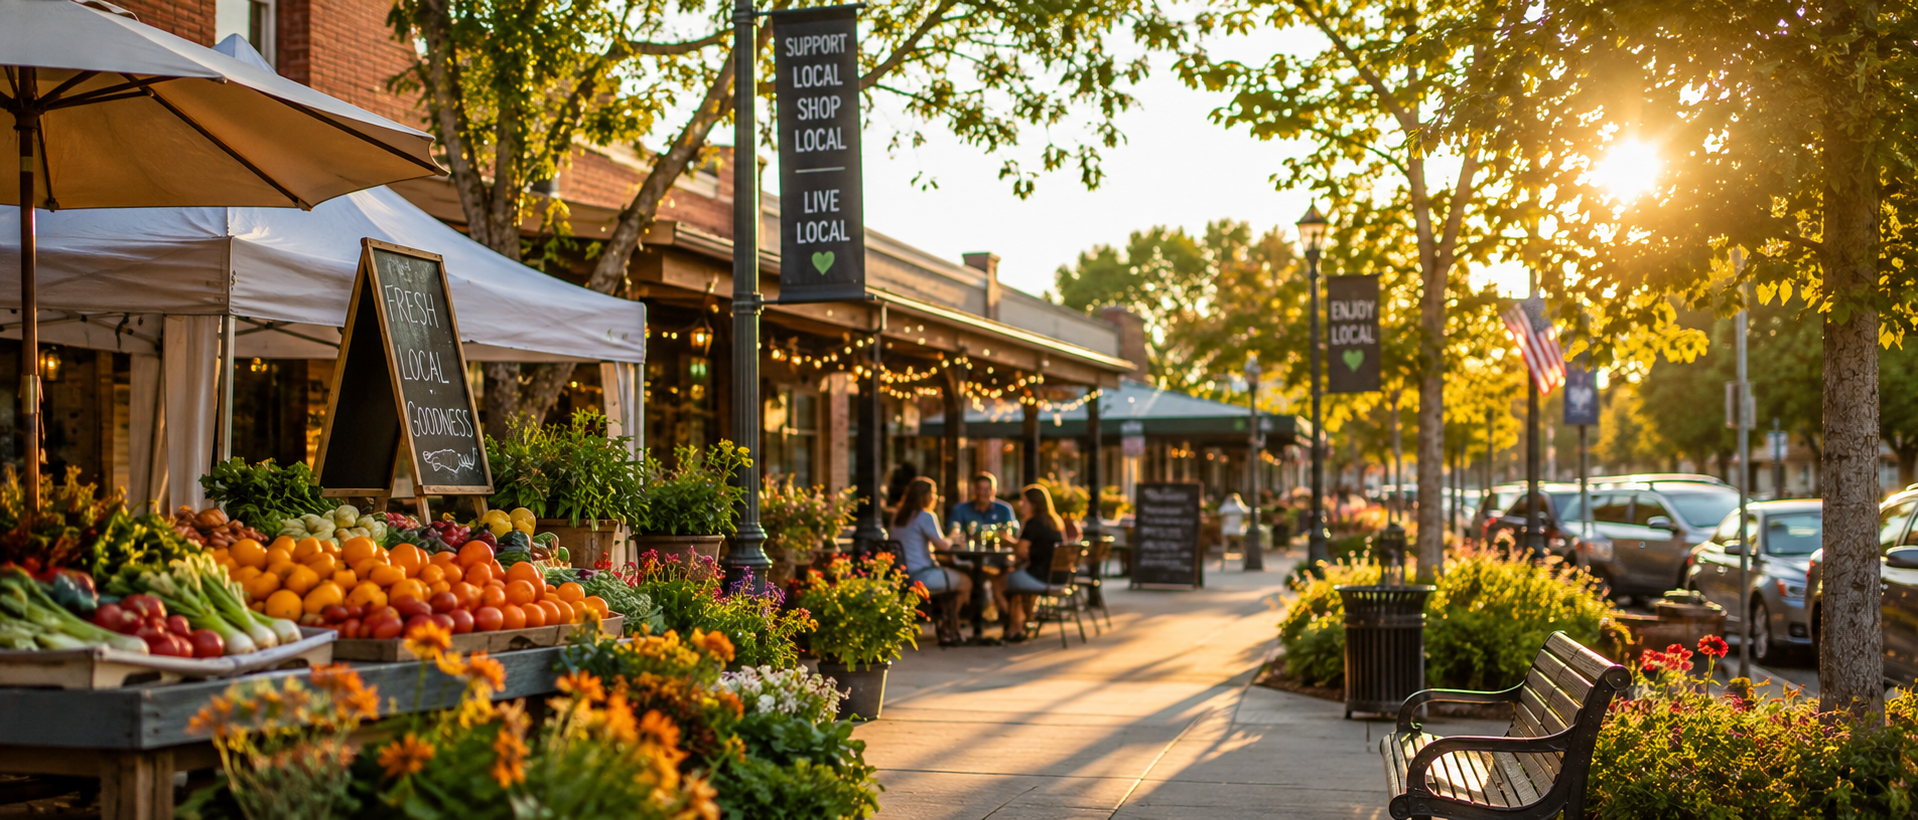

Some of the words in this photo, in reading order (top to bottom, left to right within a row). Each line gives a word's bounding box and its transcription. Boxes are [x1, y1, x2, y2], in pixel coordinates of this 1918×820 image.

[785, 33, 847, 57] SUPPORT
[793, 63, 843, 88] LOCAL
[797, 95, 841, 120] SHOP
[795, 127, 847, 152] LOCAL
[804, 189, 840, 214] LIVE
[796, 219, 850, 244] LOCAL
[385, 284, 439, 329] FRESH
[1331, 300, 1376, 320] ENJOY
[1331, 324, 1376, 345] LOCAL
[398, 344, 450, 384] LOCAL
[407, 401, 474, 438] GOODNESS
